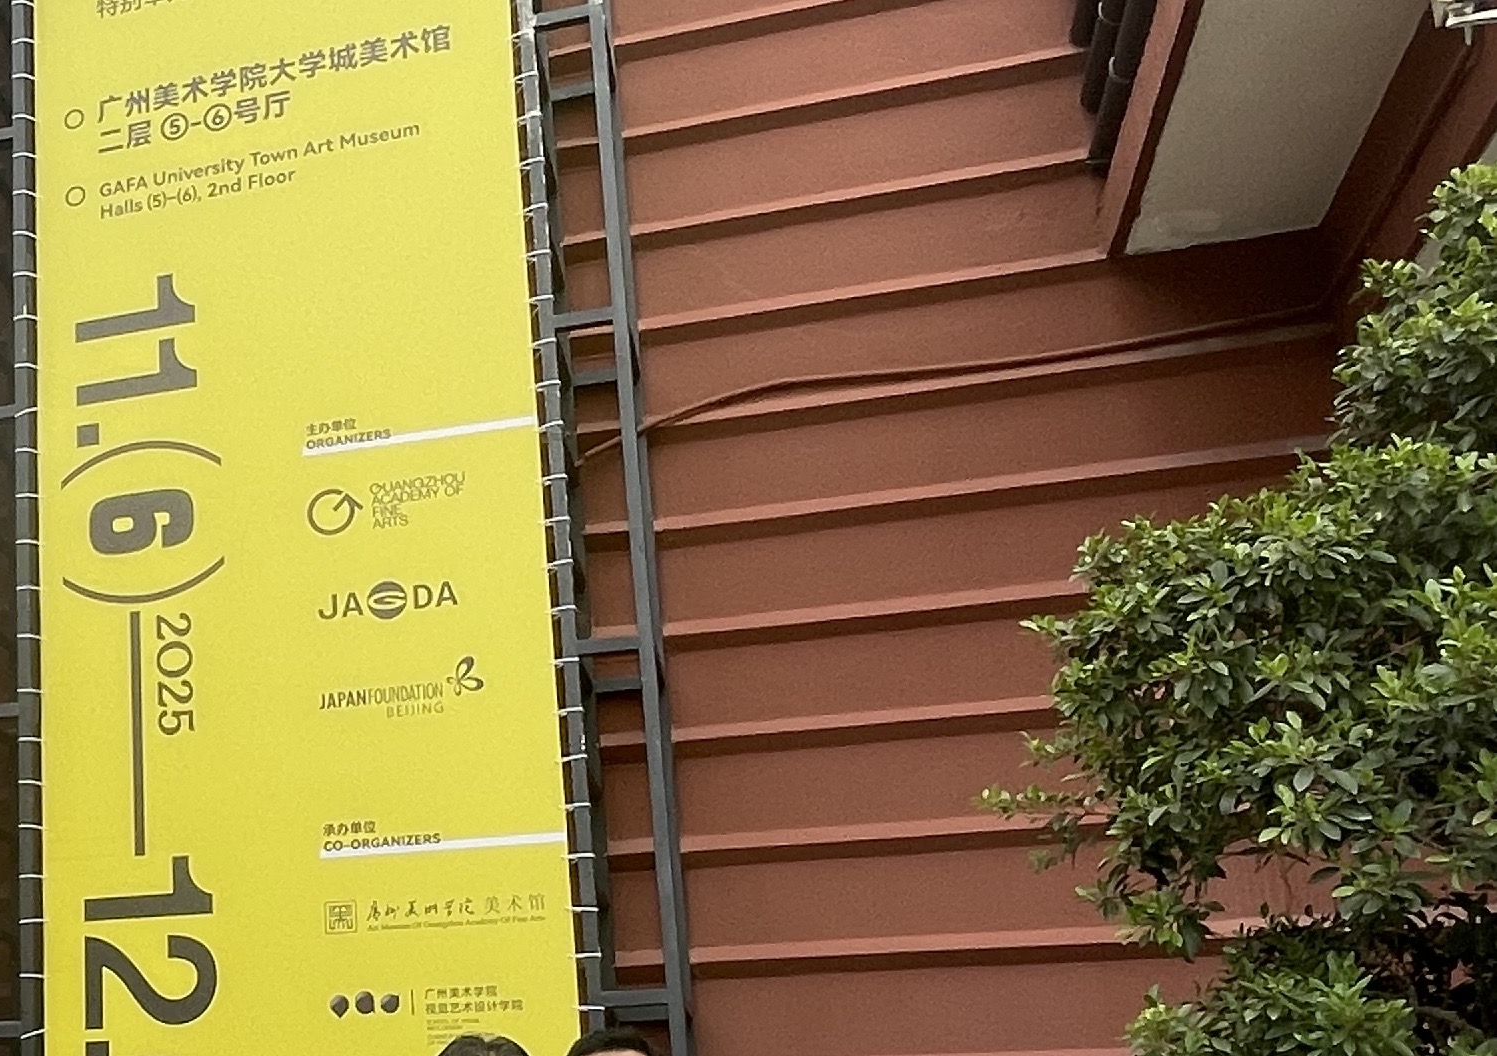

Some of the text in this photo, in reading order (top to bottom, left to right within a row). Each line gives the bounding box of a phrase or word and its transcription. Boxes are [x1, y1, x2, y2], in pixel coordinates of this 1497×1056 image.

[97, 24, 451, 123] 广州美术学院大学城美术馆
[100, 123, 420, 197] GAFA University Town Art Museum
[100, 200, 143, 219] Halls
[208, 177, 241, 198] 2nd
[248, 168, 296, 190] Floor
[306, 418, 357, 436] 主办单位
[306, 429, 392, 450] ORGANIZERS
[371, 484, 464, 507] ACADEMY OF
[372, 503, 402, 518] FINE
[372, 514, 409, 530] ARTS
[156, 612, 195, 735] 2025
[386, 702, 444, 719] BEIJING
[323, 821, 376, 837] 承办单位
[323, 833, 442, 852] CO-ORGANIZERS
[424, 985, 497, 999] 广州美术学院
